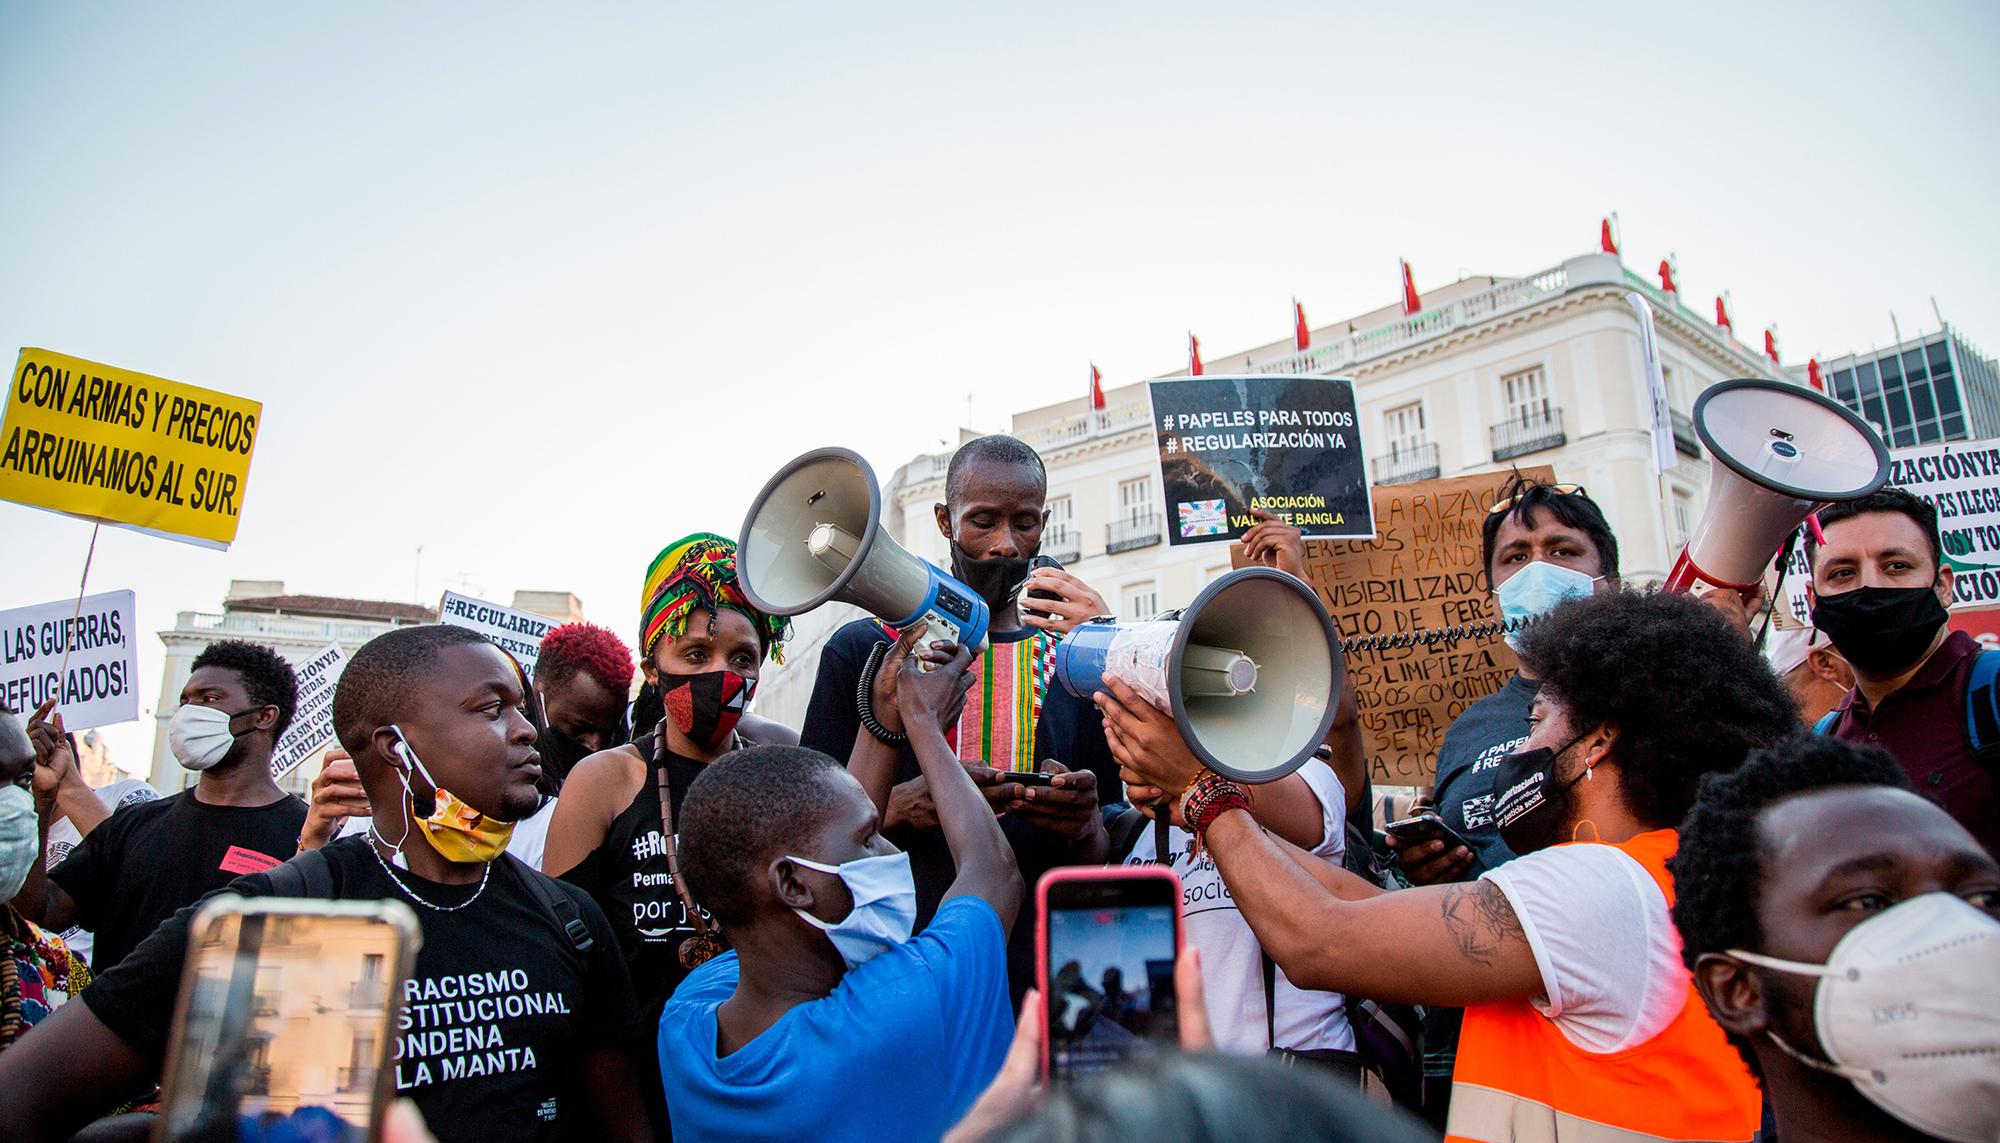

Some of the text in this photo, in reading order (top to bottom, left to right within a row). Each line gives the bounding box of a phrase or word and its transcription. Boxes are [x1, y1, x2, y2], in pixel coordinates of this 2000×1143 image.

[19, 362, 255, 455] CON ARMAS Y PRECIOS
[1163, 410, 1353, 431] # PAPELES PARA TODOS
[1166, 429, 1346, 454] # REGULARIZACIÓN YA
[1, 426, 238, 516] ARRUINAMOS AL SUR.
[1888, 446, 2000, 486] ZACIÓNYA
[1250, 493, 1325, 509] ASOCIACIÓN
[1936, 492, 1958, 518] ES
[1231, 512, 1345, 528] VALTE BANGLA
[1974, 524, 2000, 552] TO
[1368, 553, 1405, 578] LA
[1952, 563, 2000, 603] CIÓ
[445, 598, 553, 638] #REGULARIZ
[1394, 607, 1426, 633] DE
[4, 610, 125, 664] LAS GUERRAS,
[1357, 707, 1434, 731] USTICIA
[272, 731, 299, 757] ELES
[1374, 731, 1408, 752] SE
[633, 901, 671, 926] por
[403, 969, 529, 1001] RACISMO
[397, 992, 570, 1030] STITUCIONAL
[395, 1046, 537, 1090] LA MANTA
